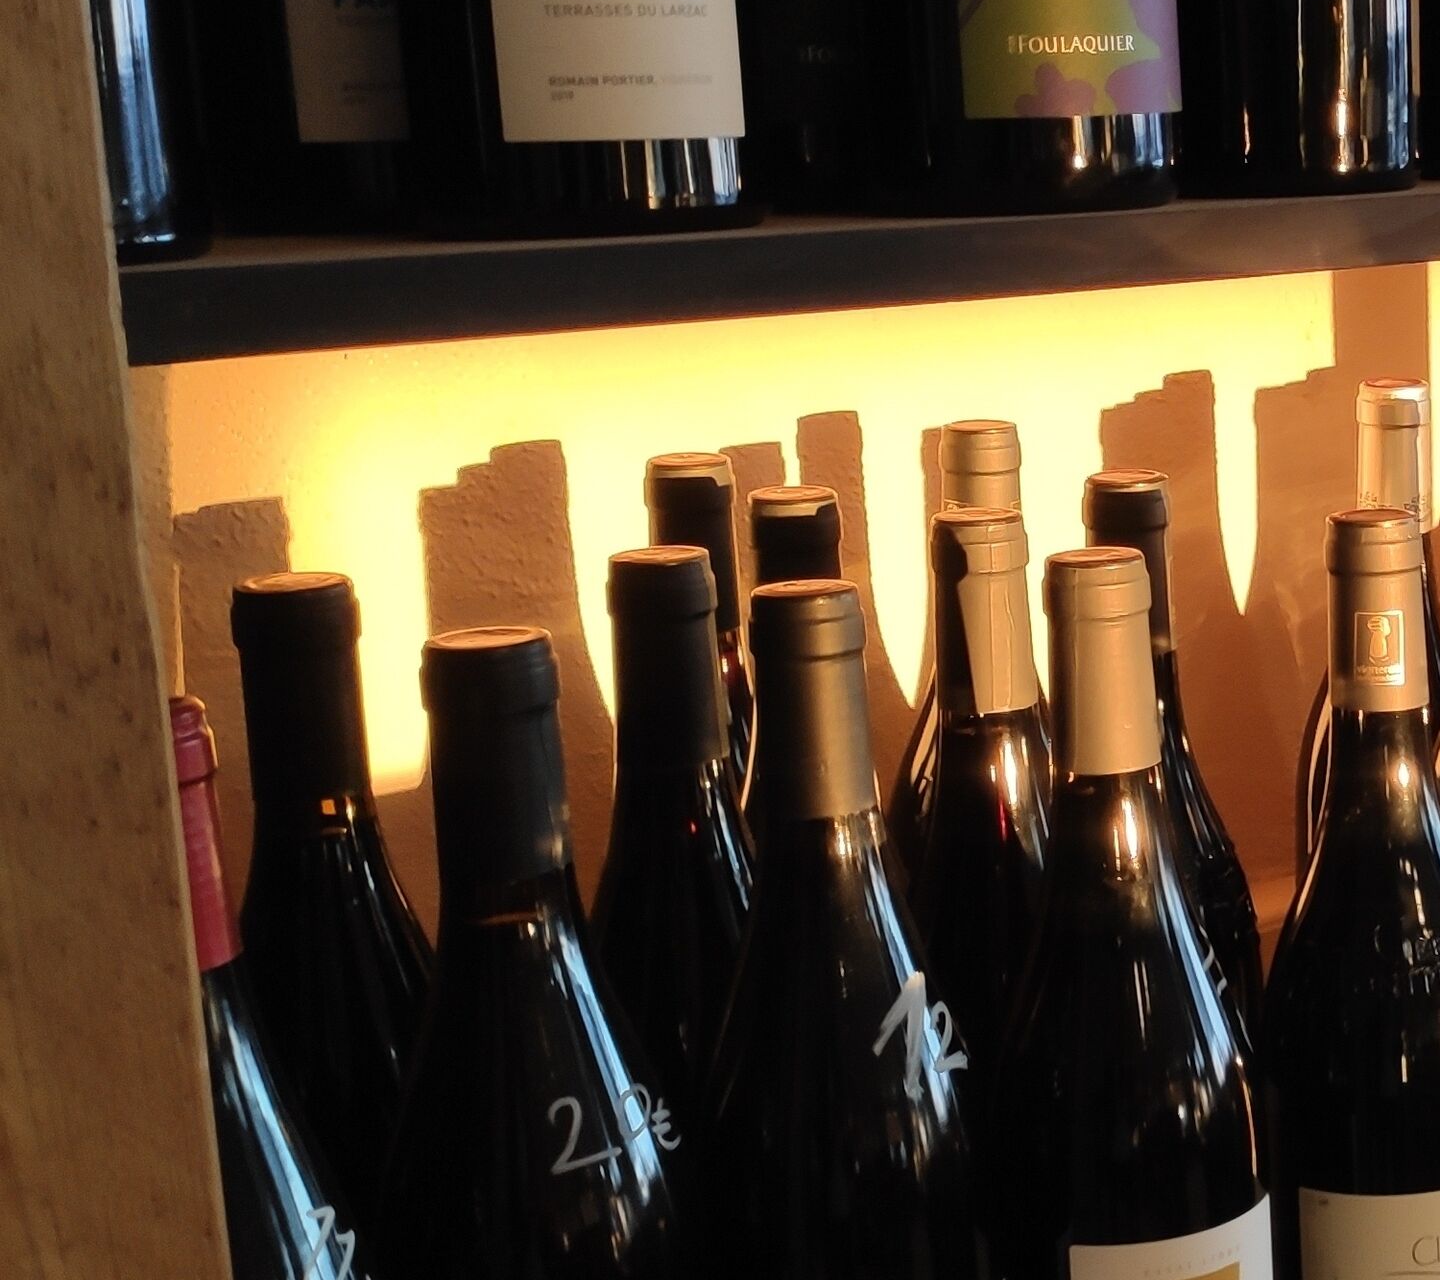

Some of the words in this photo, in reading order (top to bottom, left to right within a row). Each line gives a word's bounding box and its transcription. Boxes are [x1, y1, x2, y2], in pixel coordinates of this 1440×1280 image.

[544, 4, 633, 18] TERRASSES
[637, 4, 657, 17] DU
[660, 4, 708, 18] LARZAC
